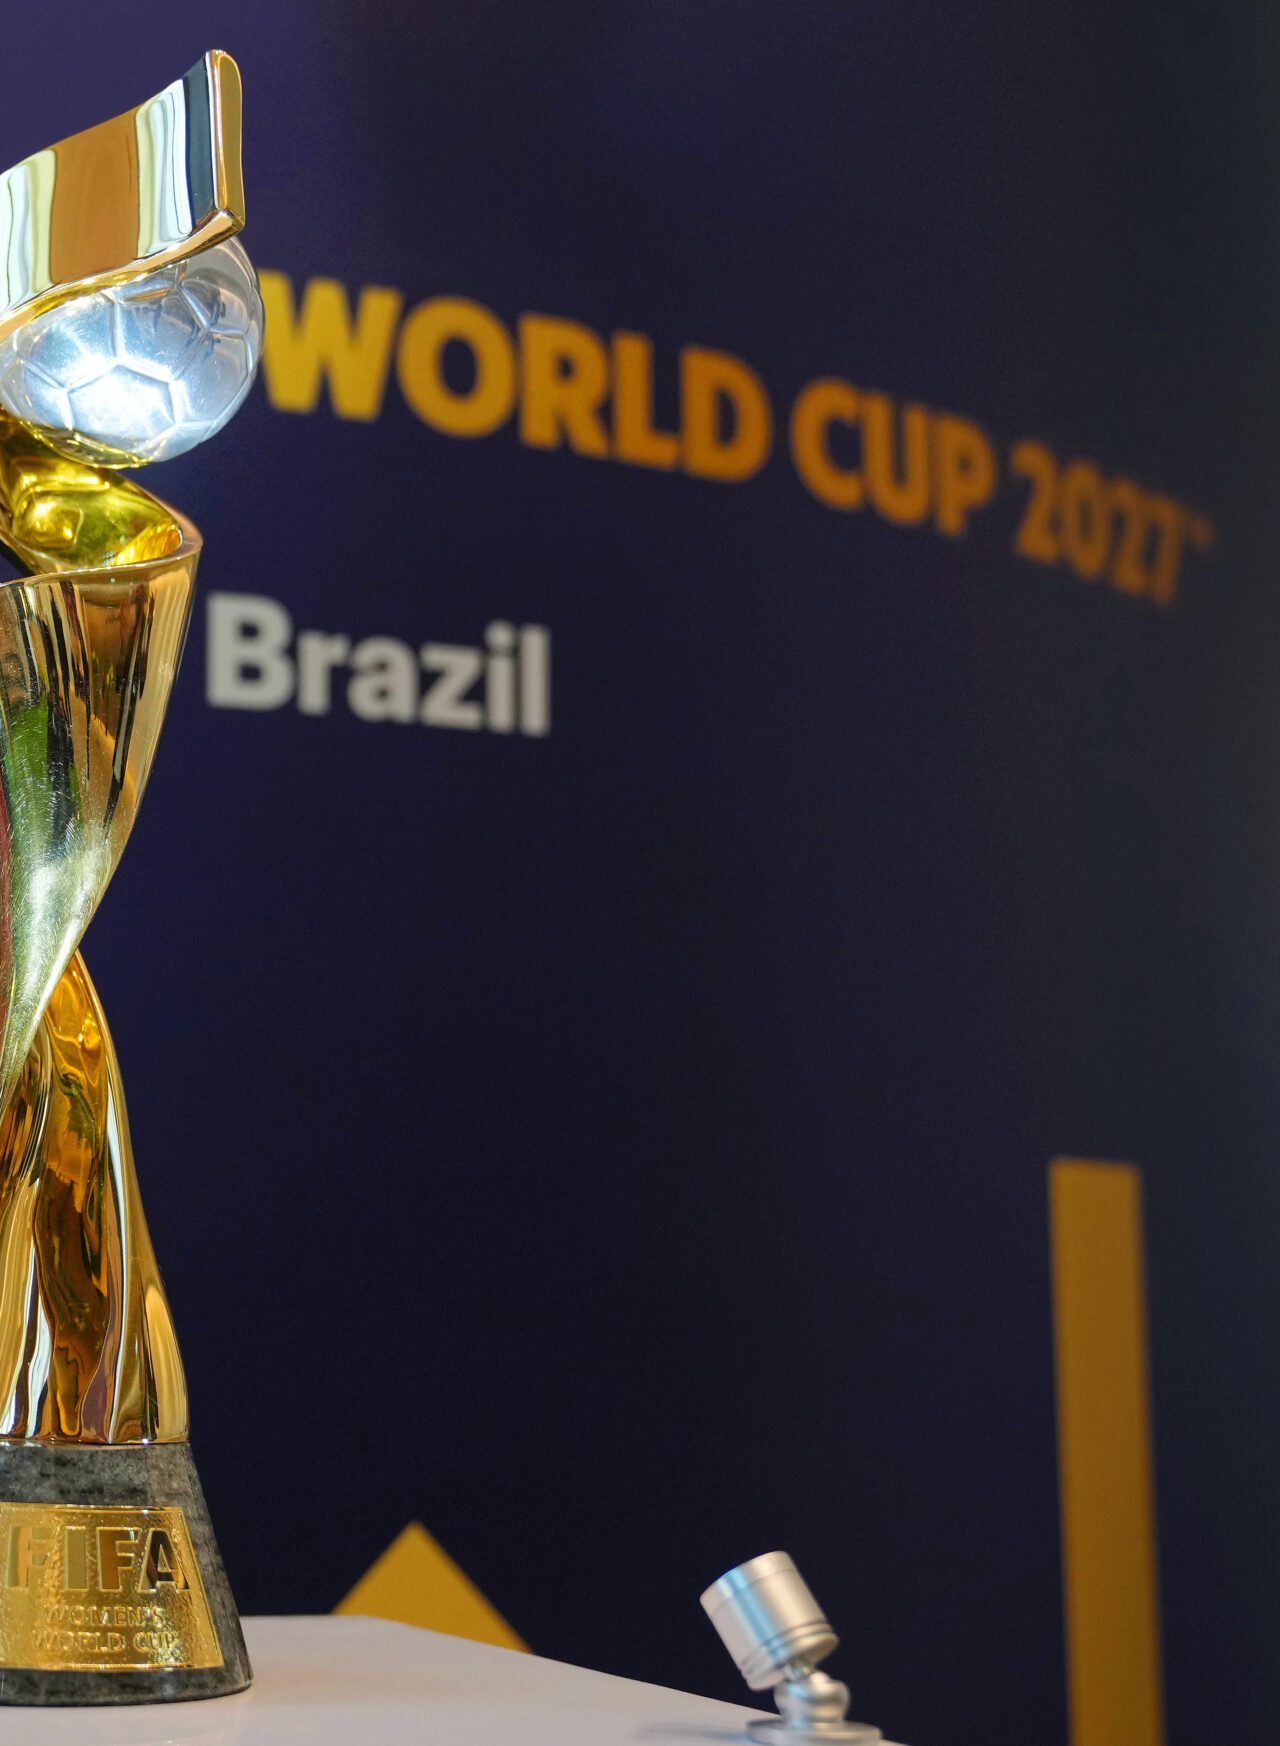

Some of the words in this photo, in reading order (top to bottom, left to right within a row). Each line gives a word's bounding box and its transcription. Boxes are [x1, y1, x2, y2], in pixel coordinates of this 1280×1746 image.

[257, 269, 773, 483] WORLD
[789, 376, 998, 537] CUP
[1010, 438, 1185, 606] 2027
[205, 591, 551, 738] Brazil
[6, 1525, 191, 1593] FIFA
[31, 1630, 126, 1653] WORLD
[132, 1631, 179, 1654] CUP
[42, 1603, 166, 1627] WOMEN'S
